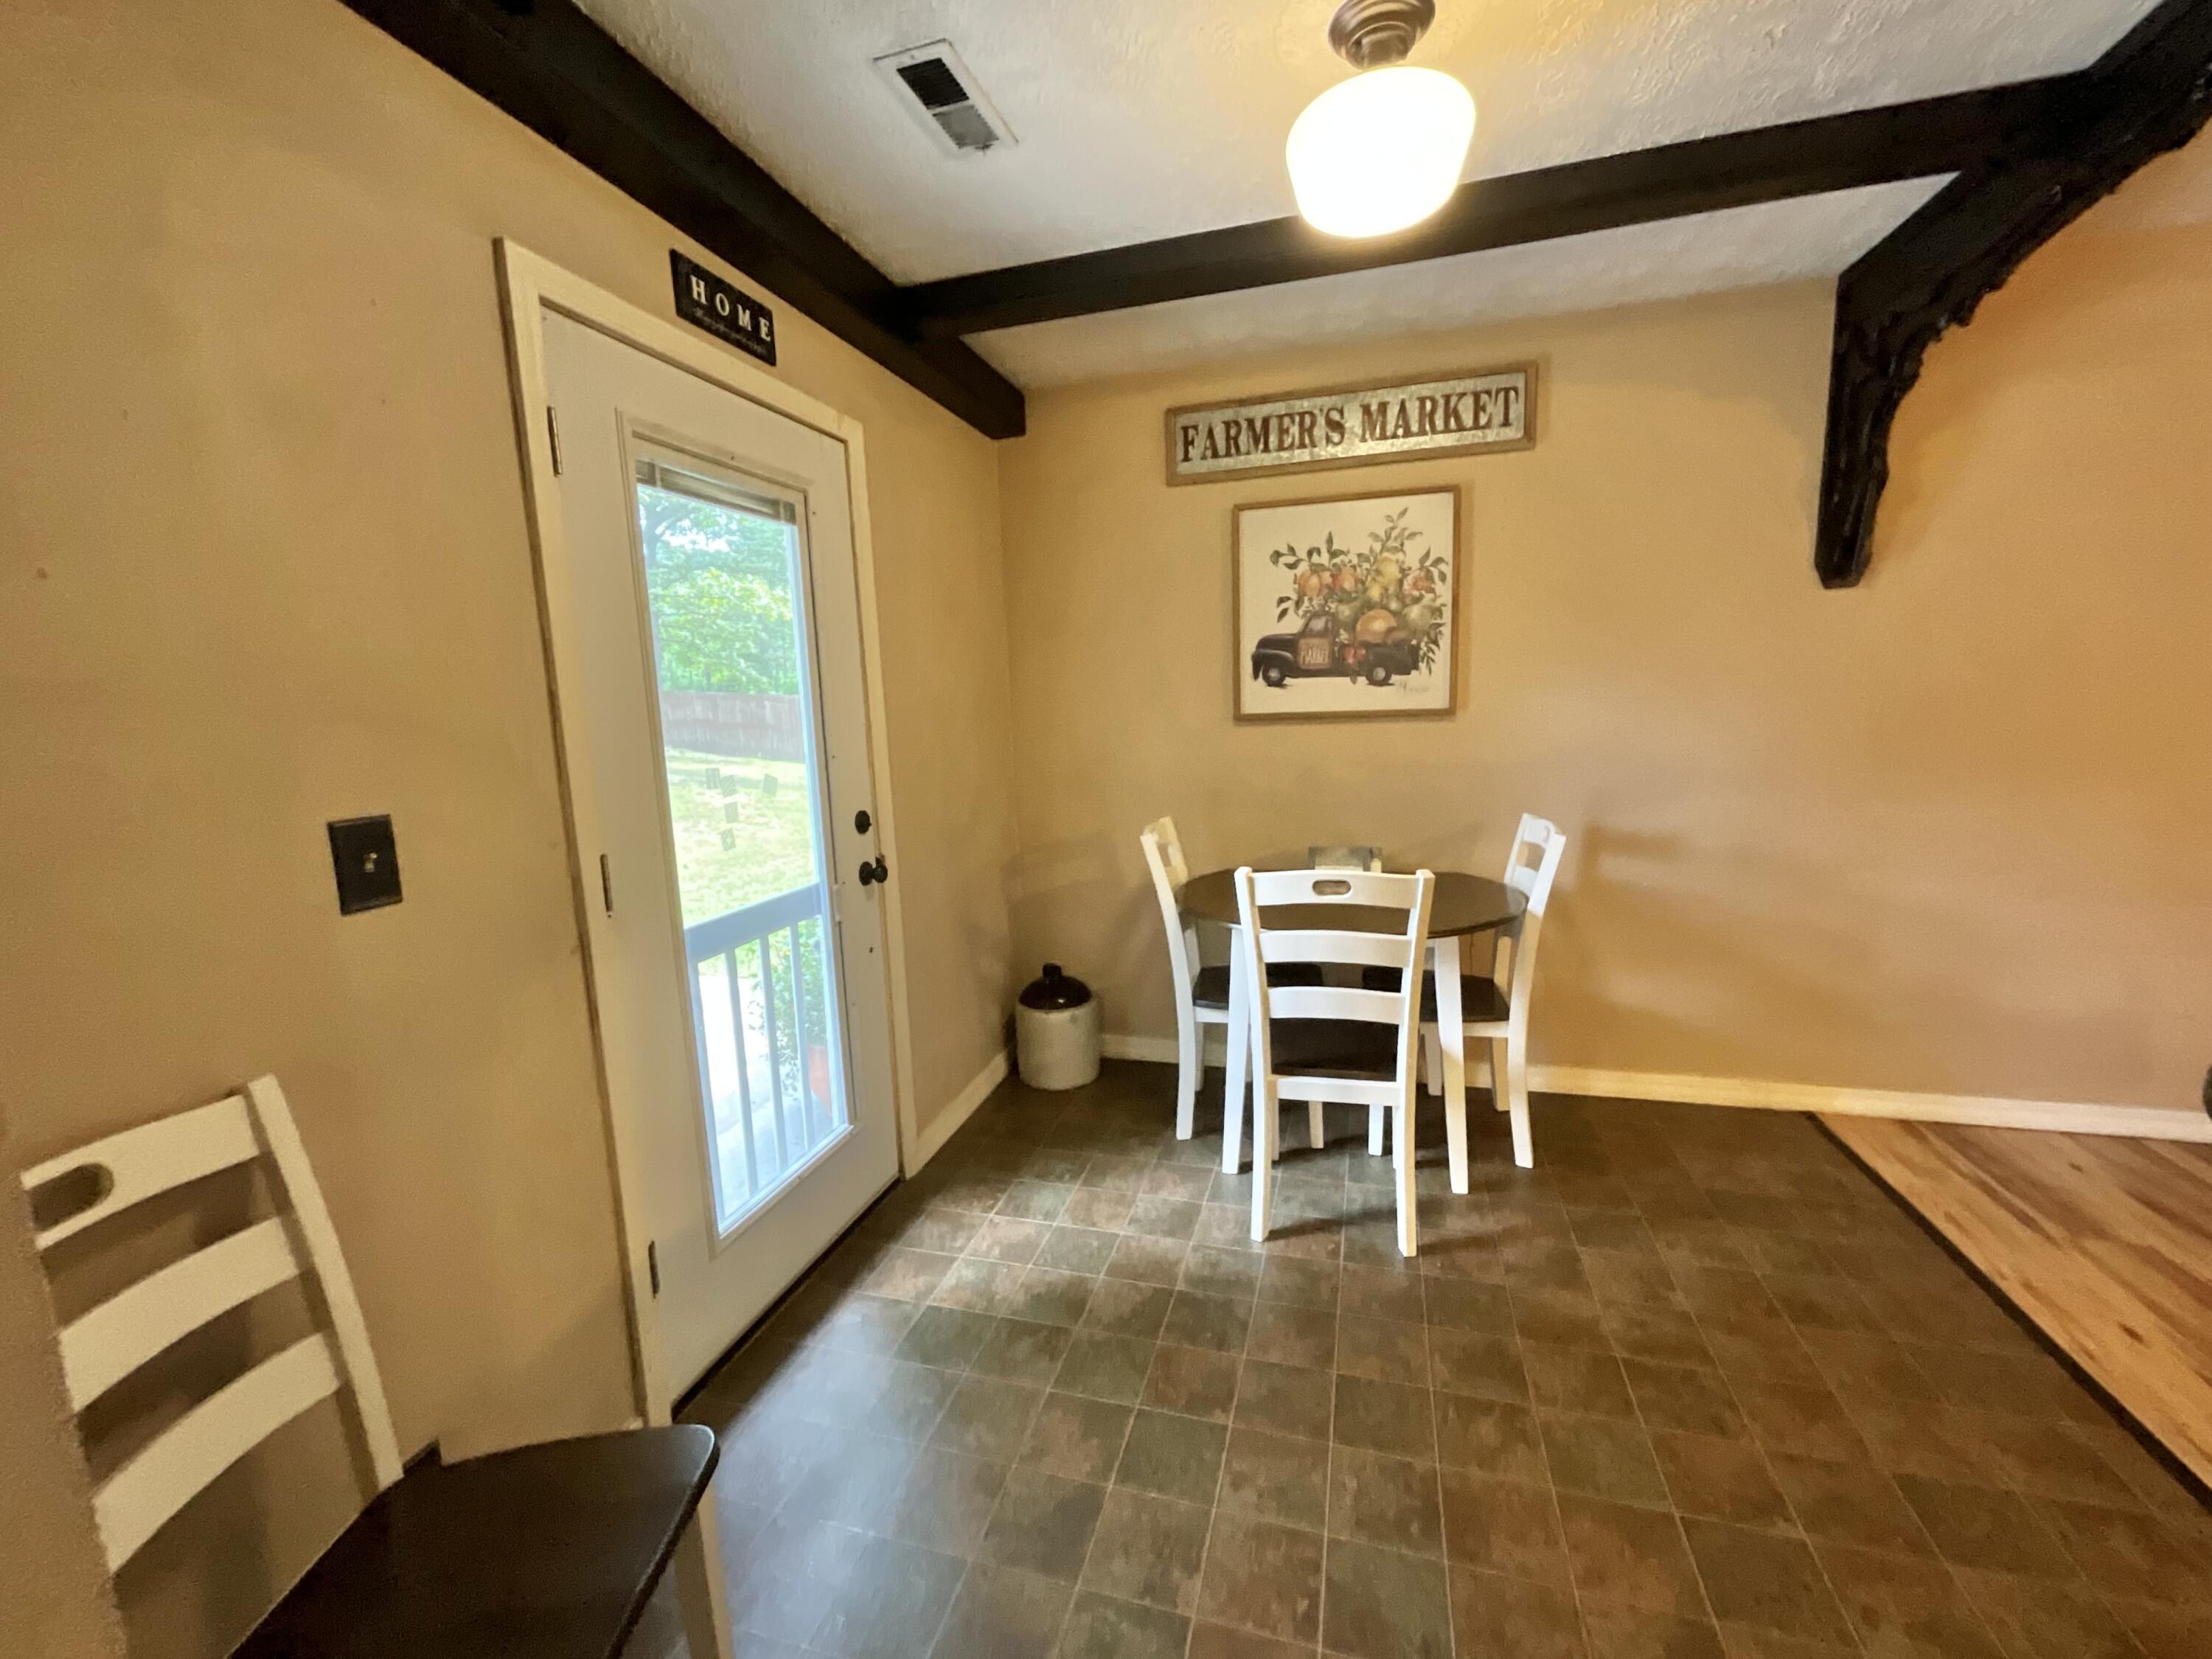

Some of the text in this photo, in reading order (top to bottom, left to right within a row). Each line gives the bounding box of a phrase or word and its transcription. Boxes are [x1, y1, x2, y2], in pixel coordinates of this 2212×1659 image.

[690, 274, 771, 341] HOME
[1180, 386, 1519, 462] FARMER'S MARKET
